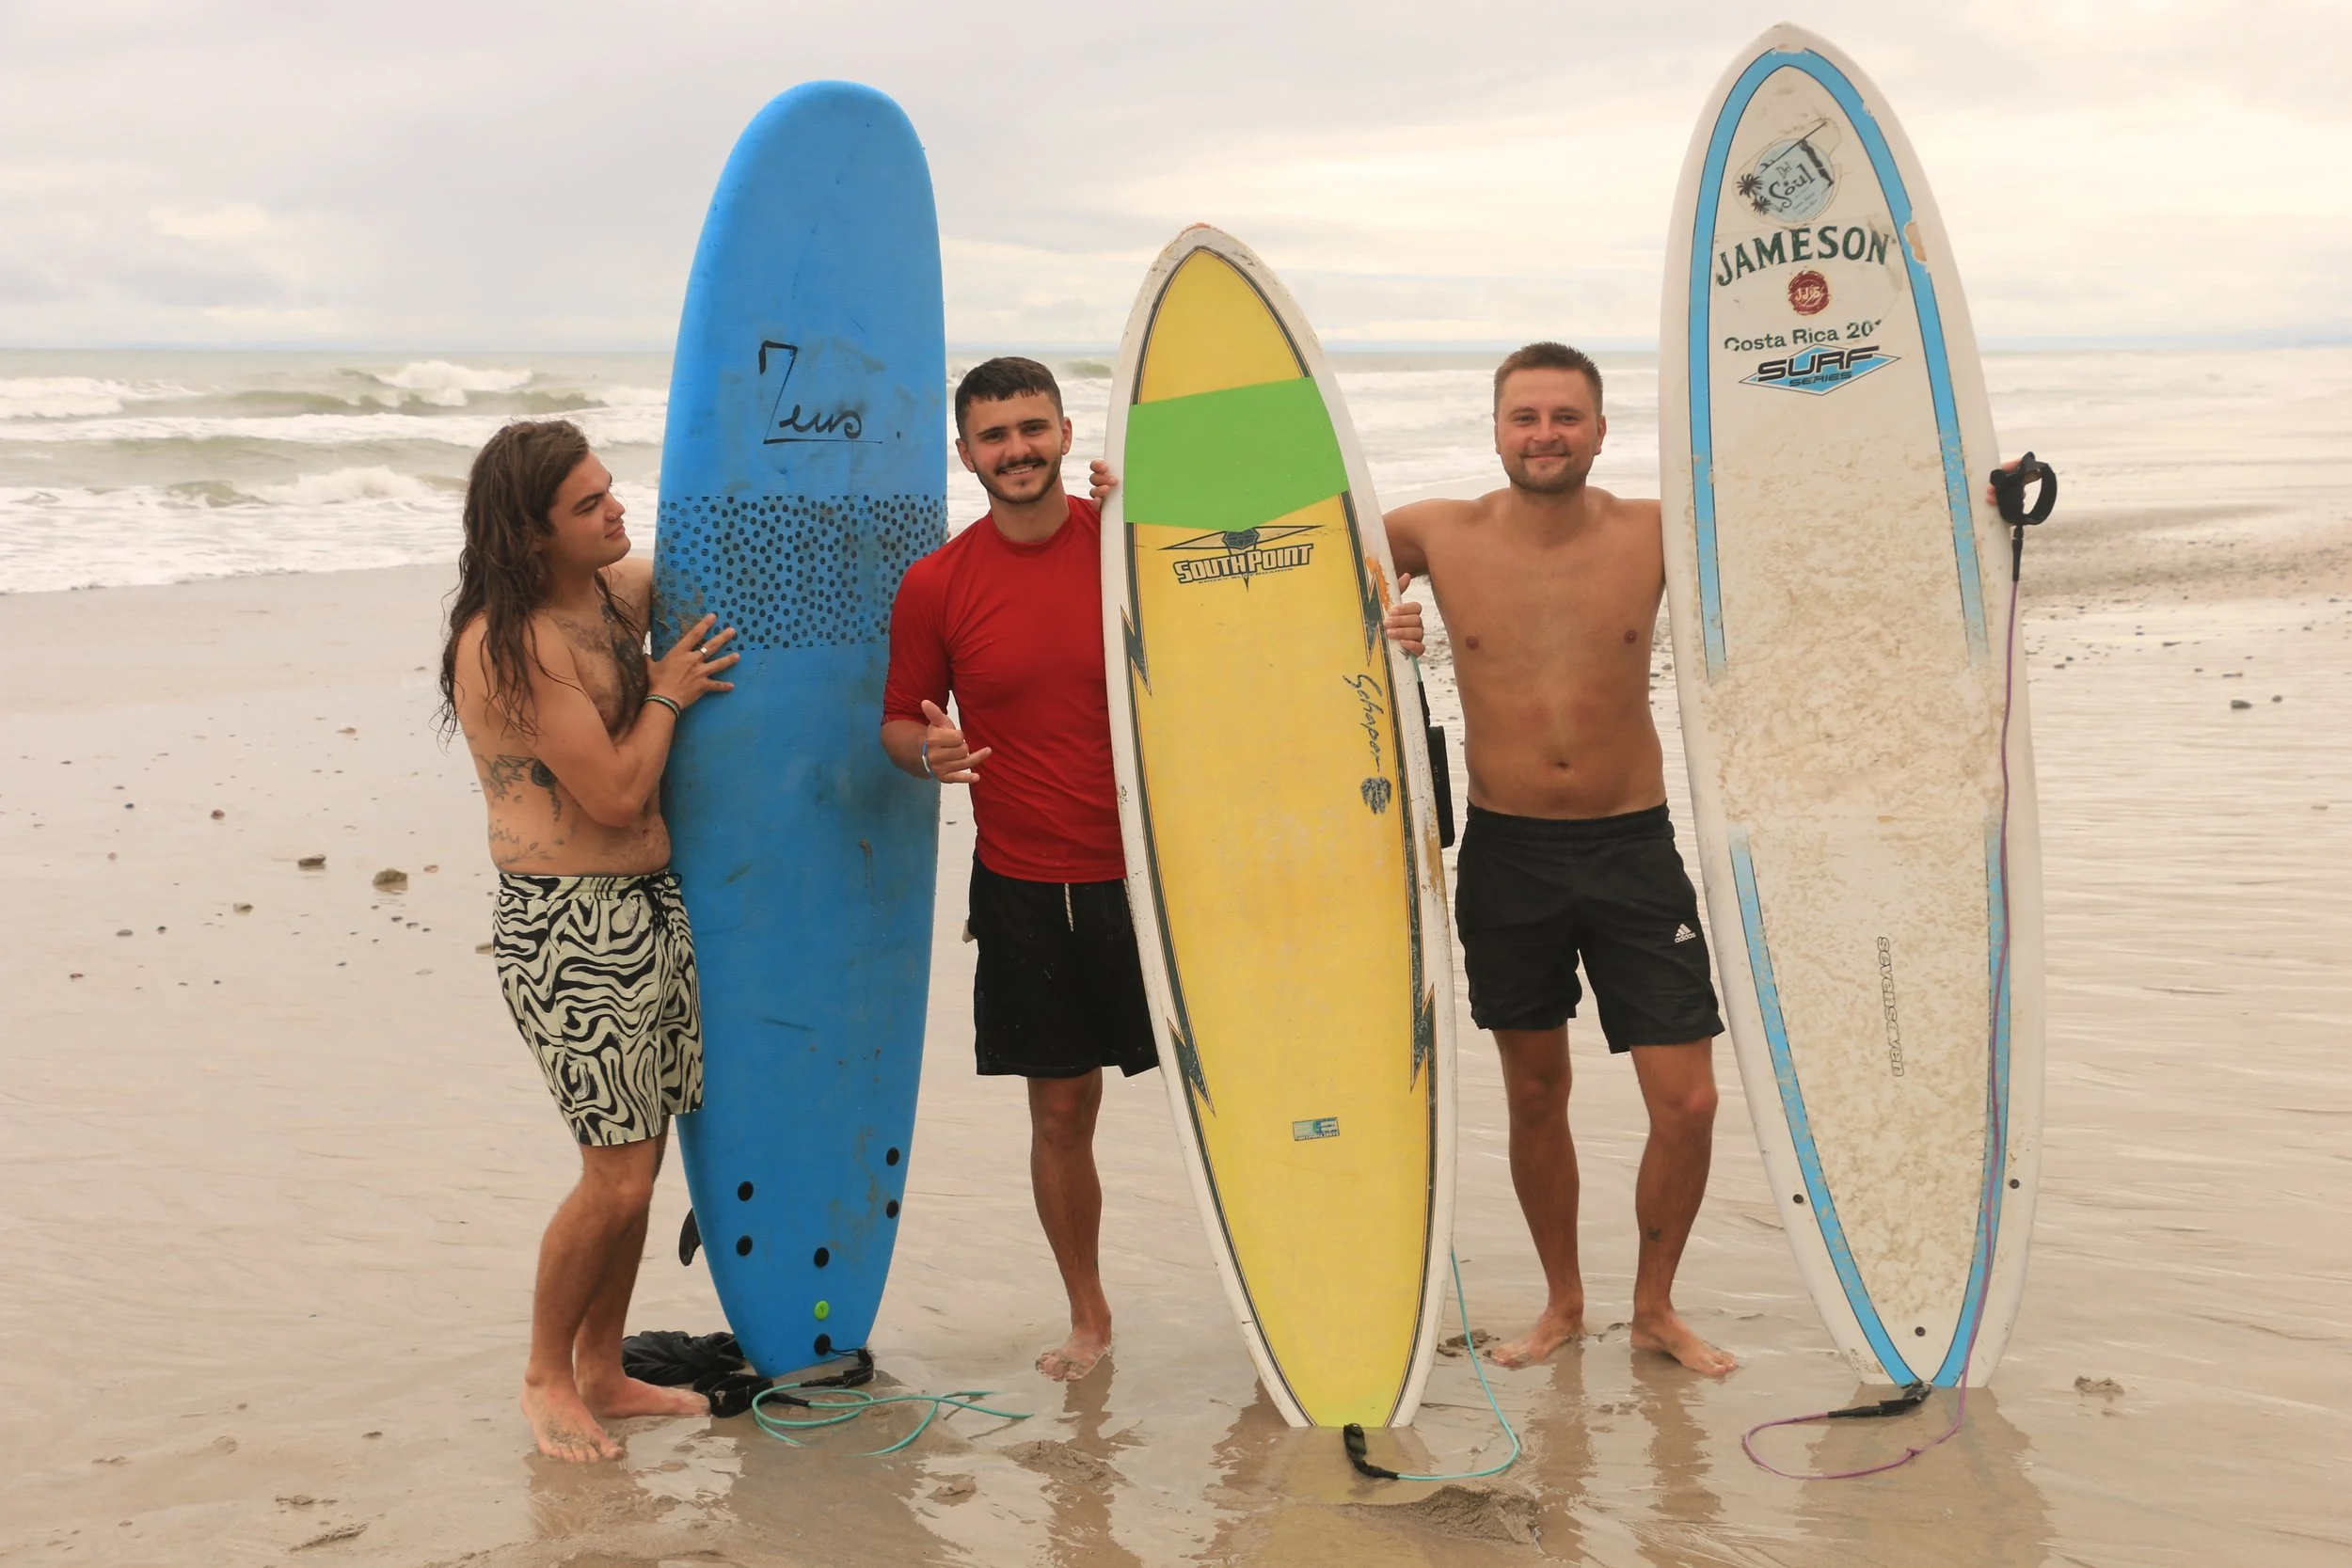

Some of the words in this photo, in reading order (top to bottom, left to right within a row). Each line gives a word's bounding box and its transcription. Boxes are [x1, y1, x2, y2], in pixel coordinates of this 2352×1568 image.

[1769, 163, 1816, 208] Soul
[1715, 226, 1890, 286] JAMESON
[1724, 333, 1787, 352] Costa
[1792, 327, 1839, 344] Rica
[1757, 345, 1880, 382] SURF
[1788, 371, 1852, 388] SERIES
[758, 341, 882, 444] Zeus
[1675, 932, 1696, 943] adidas
